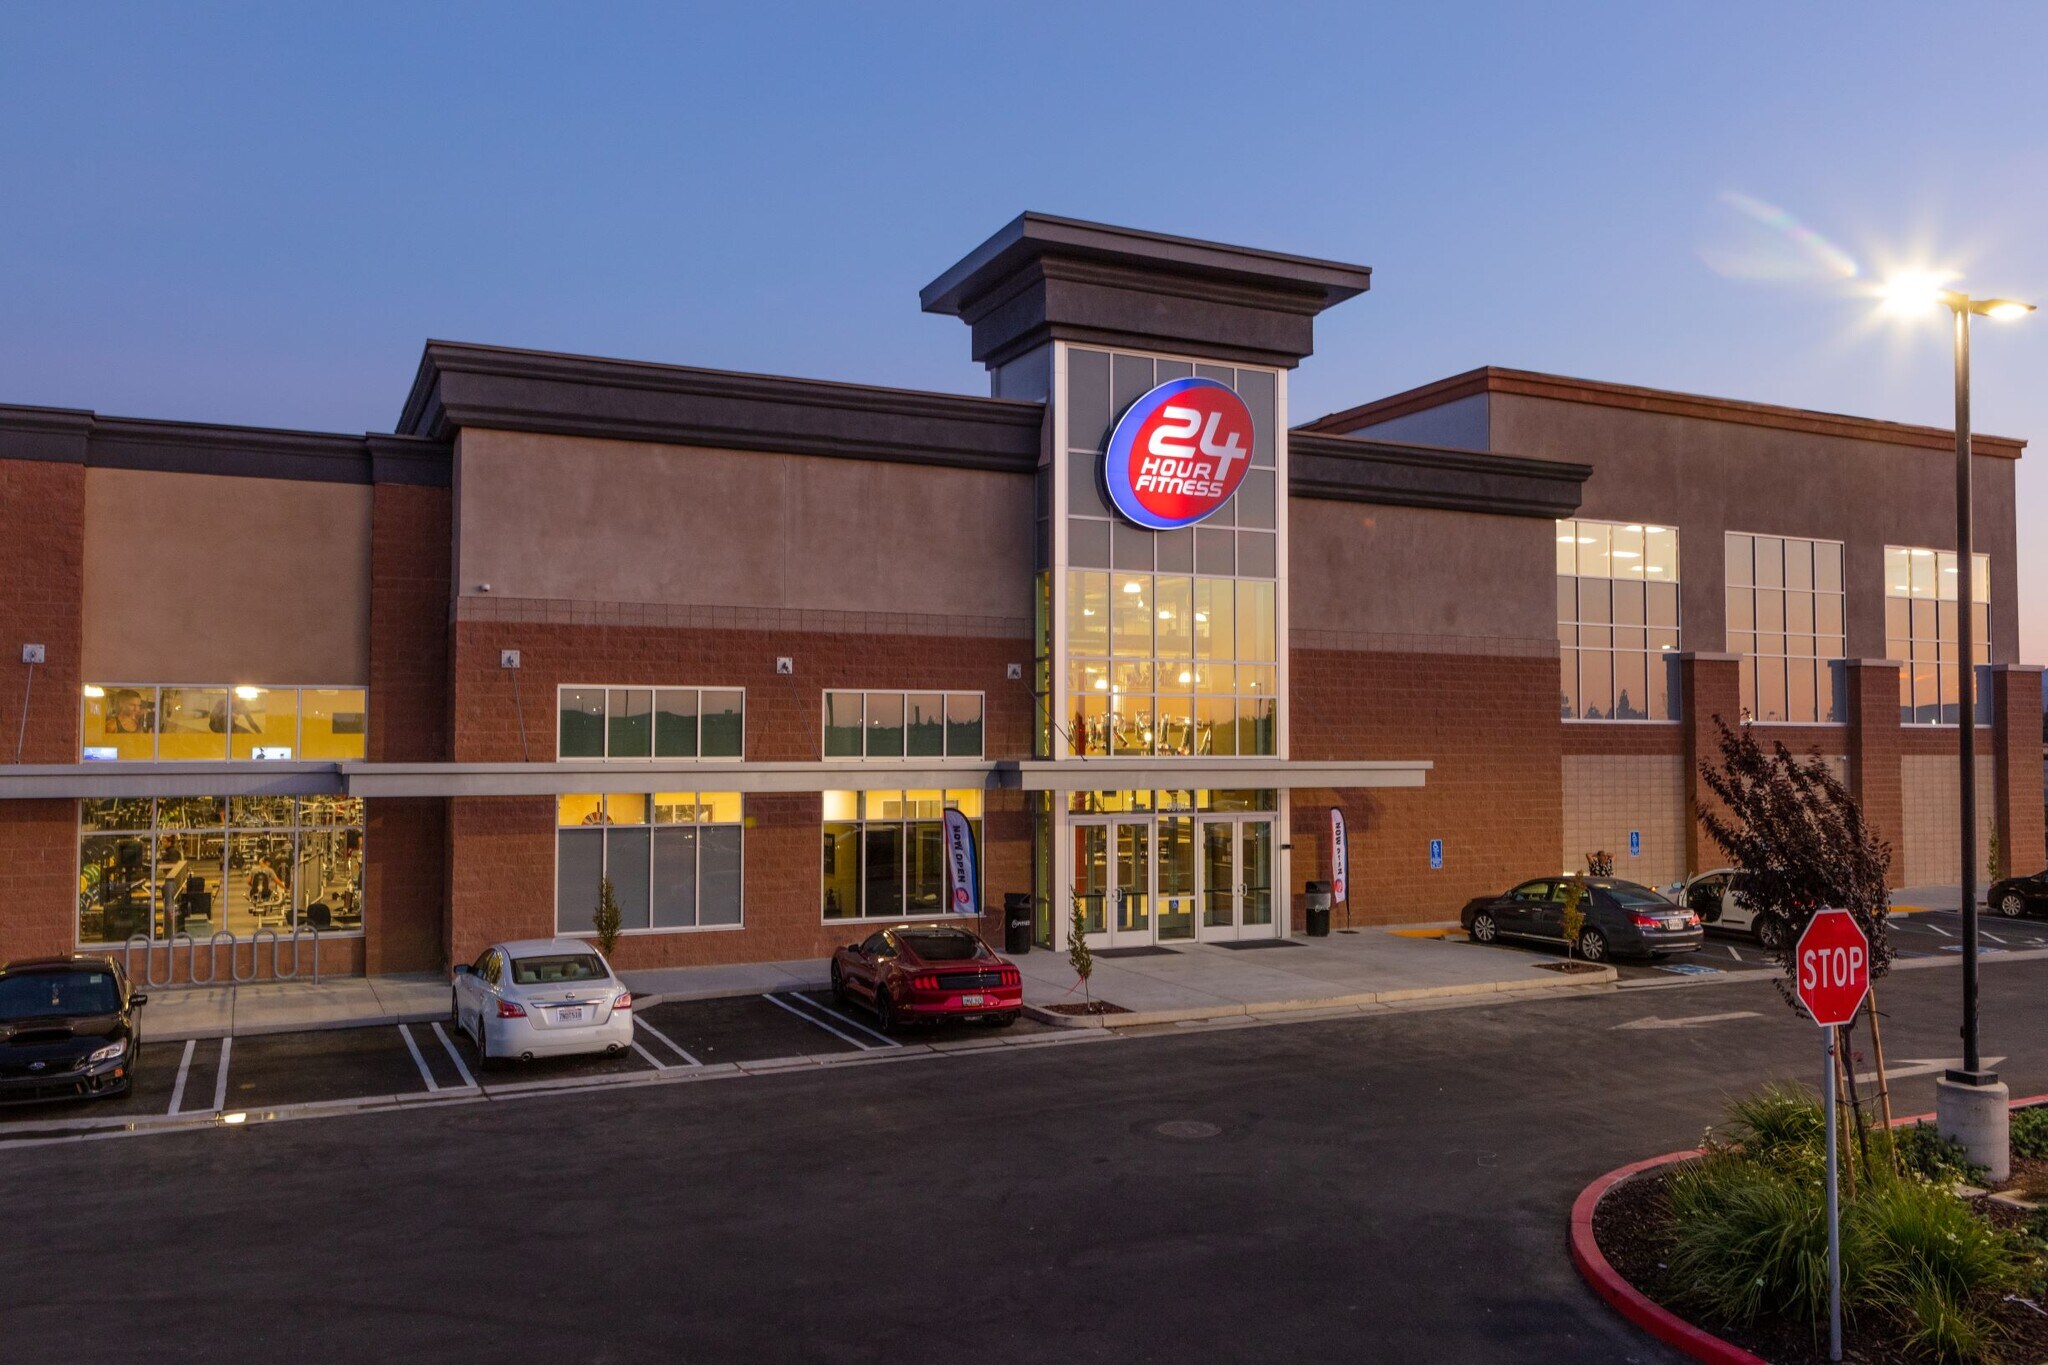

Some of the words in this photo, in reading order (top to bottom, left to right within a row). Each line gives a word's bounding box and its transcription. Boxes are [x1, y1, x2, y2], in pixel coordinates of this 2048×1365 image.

[1148, 406, 1247, 481] 24
[1140, 457, 1212, 480] HOUR
[1135, 475, 1224, 498] FITNESS
[953, 825, 964, 851] NOW
[956, 853, 966, 883] OPEN
[1803, 946, 1863, 990] STOP
